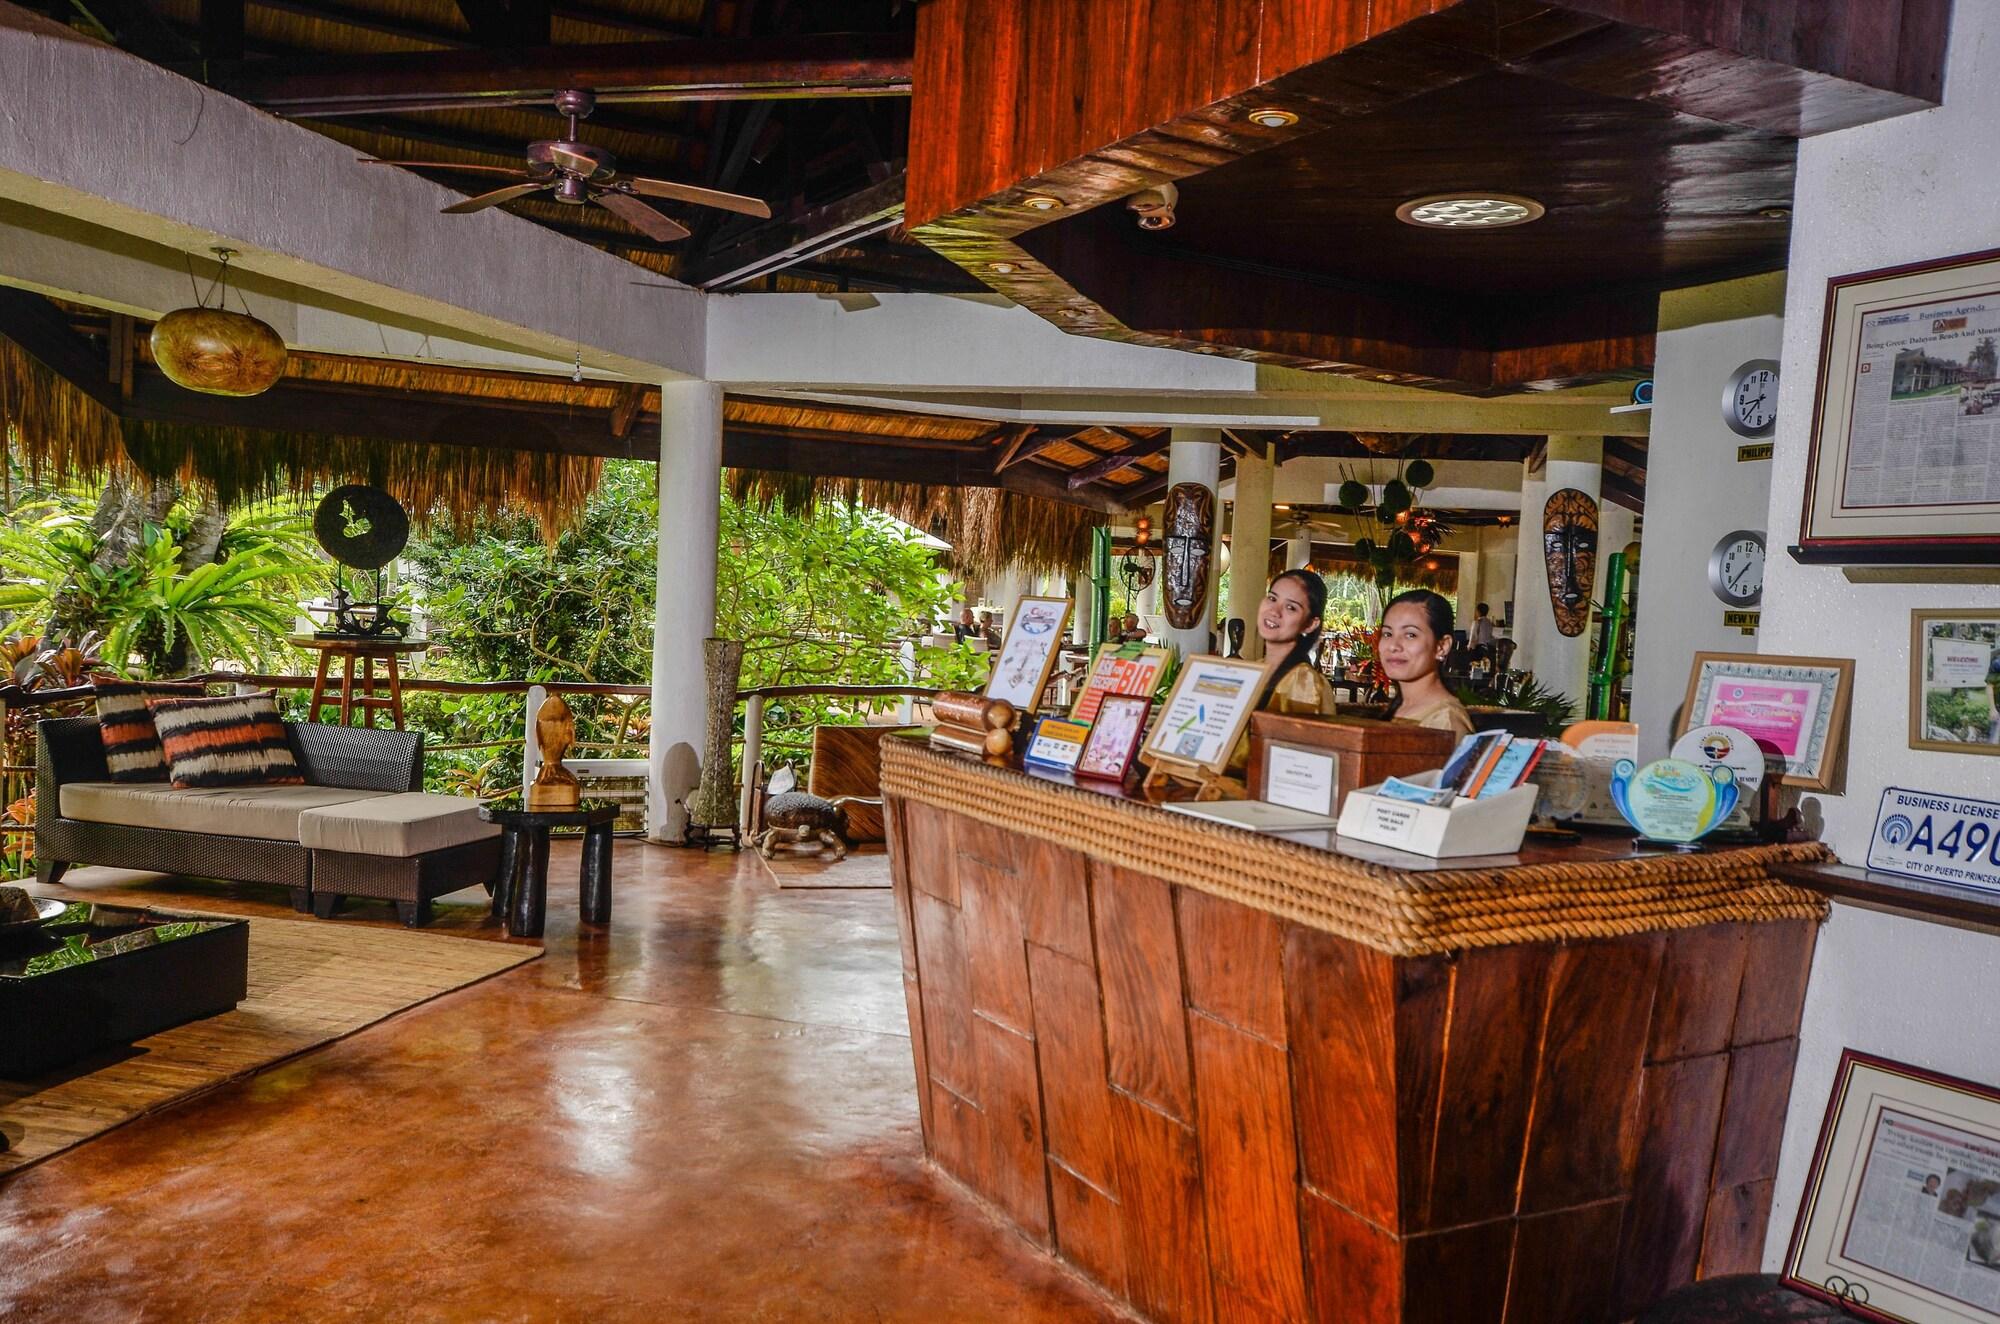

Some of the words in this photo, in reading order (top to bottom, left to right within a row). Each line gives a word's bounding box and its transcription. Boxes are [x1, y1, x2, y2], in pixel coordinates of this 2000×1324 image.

[1919, 309, 1953, 320] Business
[1955, 304, 1986, 315] Agenda
[1727, 613, 1746, 624] NEW
[1897, 794, 1950, 812] BUSINESS
[1952, 803, 2000, 820] LICENSE
[1906, 860, 1922, 870] CITY
[1923, 864, 1934, 873] OF
[1935, 867, 1964, 878] PUERTO
